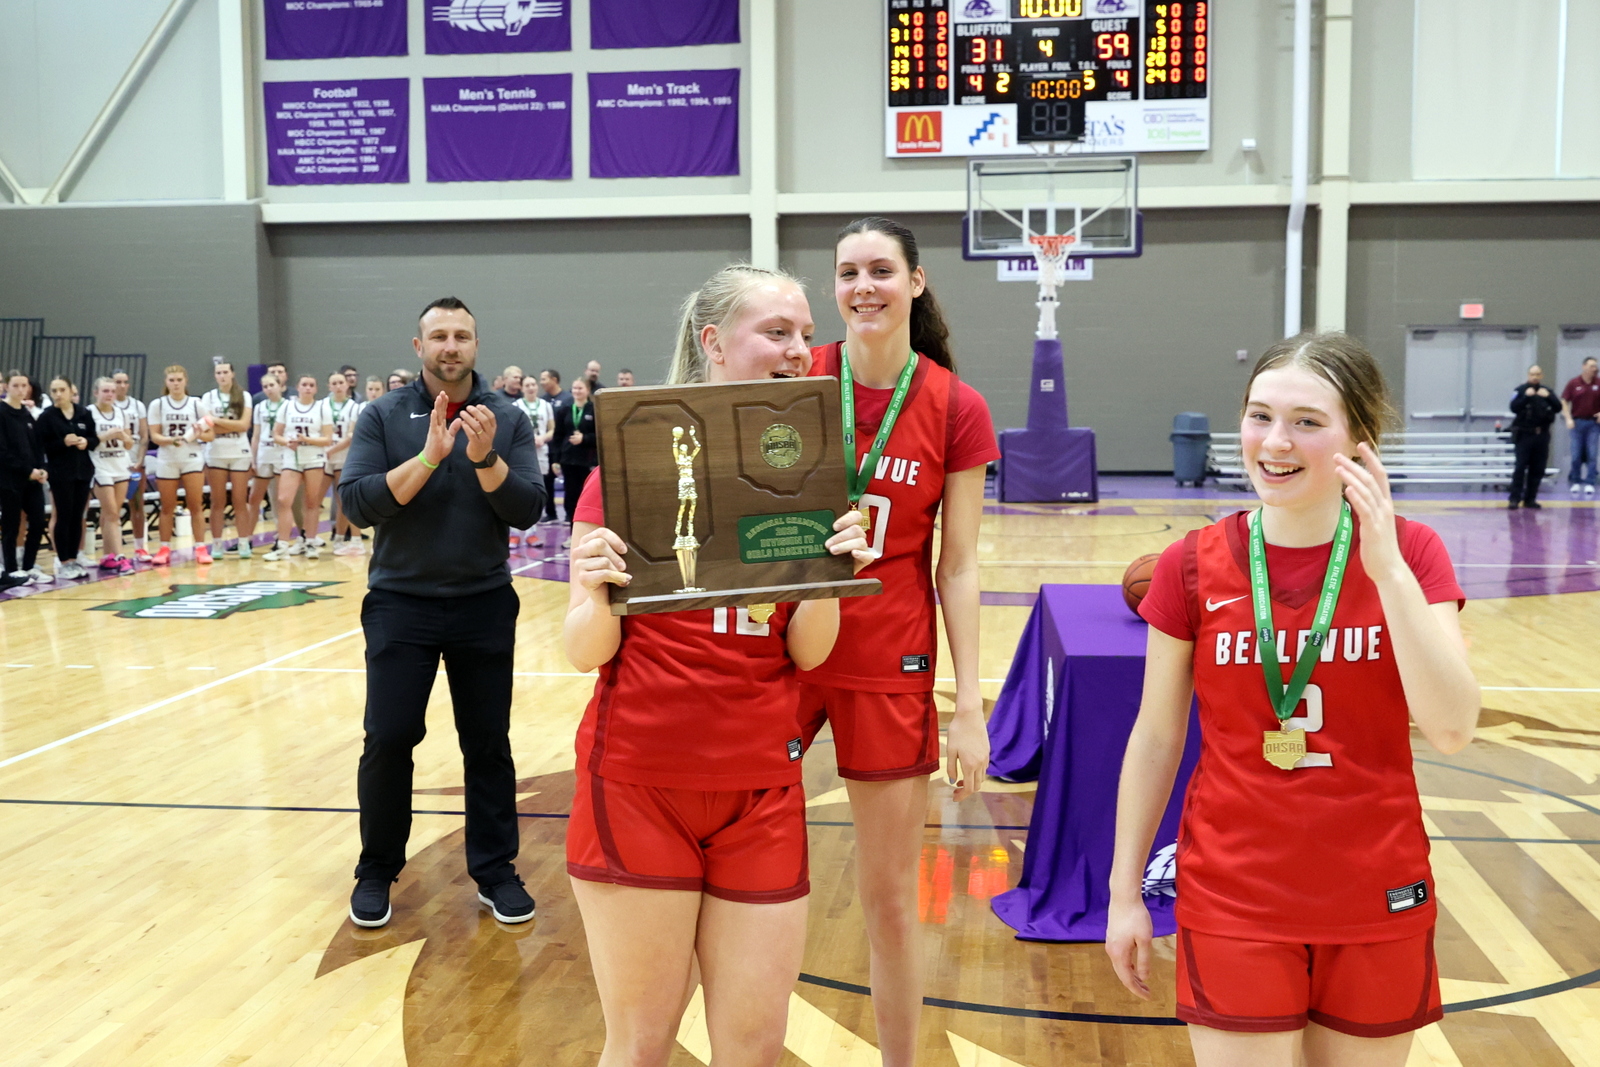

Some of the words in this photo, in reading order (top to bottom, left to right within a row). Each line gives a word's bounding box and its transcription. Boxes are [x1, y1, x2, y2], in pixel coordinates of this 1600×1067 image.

[898, 14, 910, 26] 4
[913, 12, 924, 27] 0
[936, 10, 947, 26] 0
[1156, 4, 1167, 18] 4
[1170, 2, 1182, 18] 0
[1196, 2, 1206, 17] 3
[890, 28, 910, 43] 31
[913, 27, 924, 42] 0
[936, 26, 947, 41] 2
[956, 22, 1012, 37] BLUFFTON
[1032, 27, 1060, 37] PERIOD
[1092, 19, 1129, 33] GUEST
[1156, 18, 1167, 35] 5
[1170, 18, 1181, 34] 0
[1194, 18, 1206, 33] 0
[894, 45, 910, 58] 14
[913, 44, 924, 58] 0
[936, 42, 947, 58] 0
[972, 38, 1003, 63] 31
[1038, 39, 1053, 58] 4
[1097, 34, 1130, 59] 59
[1151, 36, 1167, 51] 13
[1170, 36, 1181, 51] 0
[1194, 34, 1206, 50] 0
[890, 59, 910, 75] 33
[918, 60, 924, 73] 1
[936, 59, 947, 72] 4
[1020, 62, 1050, 72] PLAYER
[1052, 62, 1072, 71] FOUL
[1106, 60, 1132, 70] FOULS
[1170, 51, 1181, 67] 0
[1194, 50, 1206, 66] 0
[961, 64, 986, 74] FOULS
[1146, 68, 1167, 84] 24
[1170, 68, 1181, 83] 0
[1194, 67, 1206, 82] 0
[890, 76, 910, 91] 34
[918, 76, 924, 89] 1
[936, 74, 947, 89] 0
[968, 74, 983, 92] 4
[996, 72, 1011, 93] 2
[1083, 70, 1096, 91] 5
[1115, 70, 1129, 88] 4
[313, 87, 358, 98] Football
[459, 88, 495, 101] Men's
[496, 87, 537, 100] Tennis
[628, 84, 664, 96] Men's
[666, 82, 700, 95] Track
[1031, 80, 1081, 100] 10:00
[452, 104, 497, 113] Champions
[596, 100, 616, 108] AMC
[892, 390, 904, 408] ATHLETIC
[291, 416, 314, 424] GENOA
[882, 410, 896, 434] ASSOCIATION
[169, 424, 187, 437] 25
[746, 518, 785, 540] REGIONAL
[786, 517, 829, 536] CHAMPION
[1340, 530, 1348, 542] HIGH
[760, 536, 803, 548] DIVISION
[804, 535, 815, 544] IV
[1253, 538, 1261, 558] SCHOOL
[746, 549, 773, 559] GIRLS
[774, 544, 828, 557] BASKETBAL
[1335, 544, 1345, 563] SCHOOL
[1255, 560, 1264, 585] ATHLETIC
[1328, 566, 1341, 590] ATHLETIC
[1258, 588, 1267, 620] ASSOCIATION
[1319, 592, 1334, 625] ASSOCIATION
[1282, 684, 1333, 769] 2
[1266, 742, 1304, 754] OHSAA
[1417, 888, 1424, 898] S
